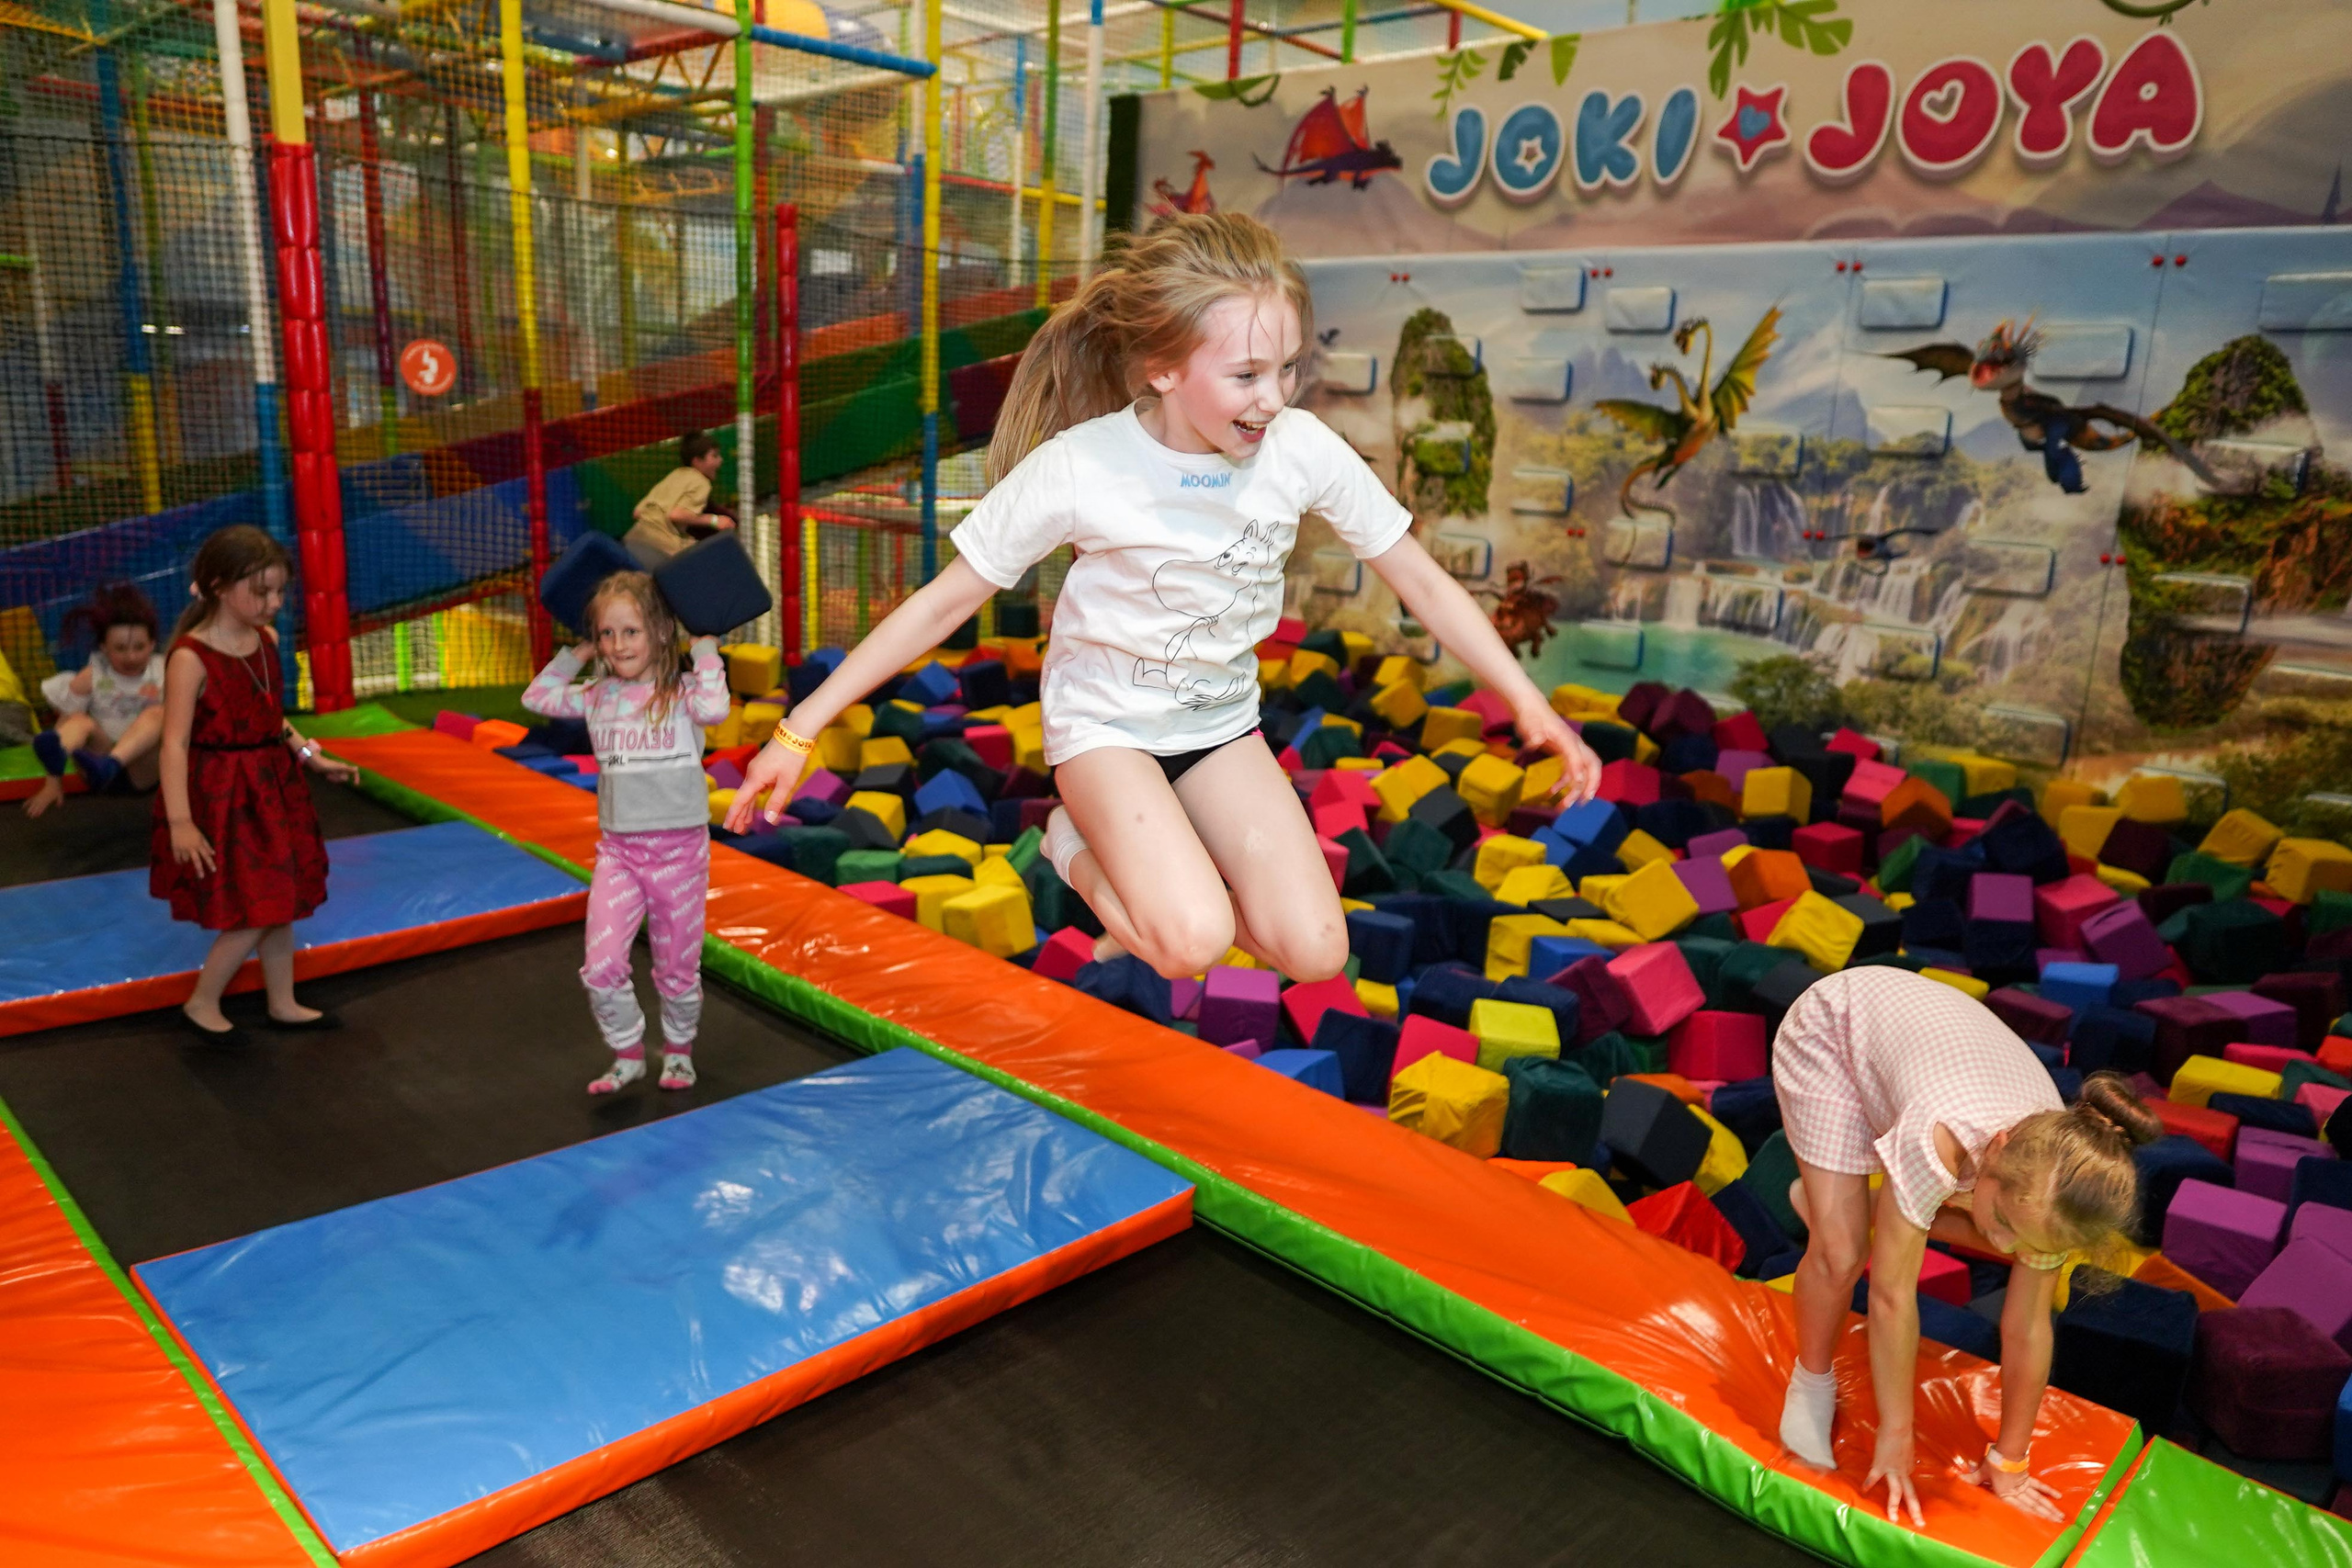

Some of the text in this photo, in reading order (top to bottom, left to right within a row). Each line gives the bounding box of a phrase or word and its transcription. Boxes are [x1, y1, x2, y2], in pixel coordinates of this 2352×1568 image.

[1426, 29, 2202, 198] JOKI JOYA
[1180, 472, 1232, 488] MOOMIN
